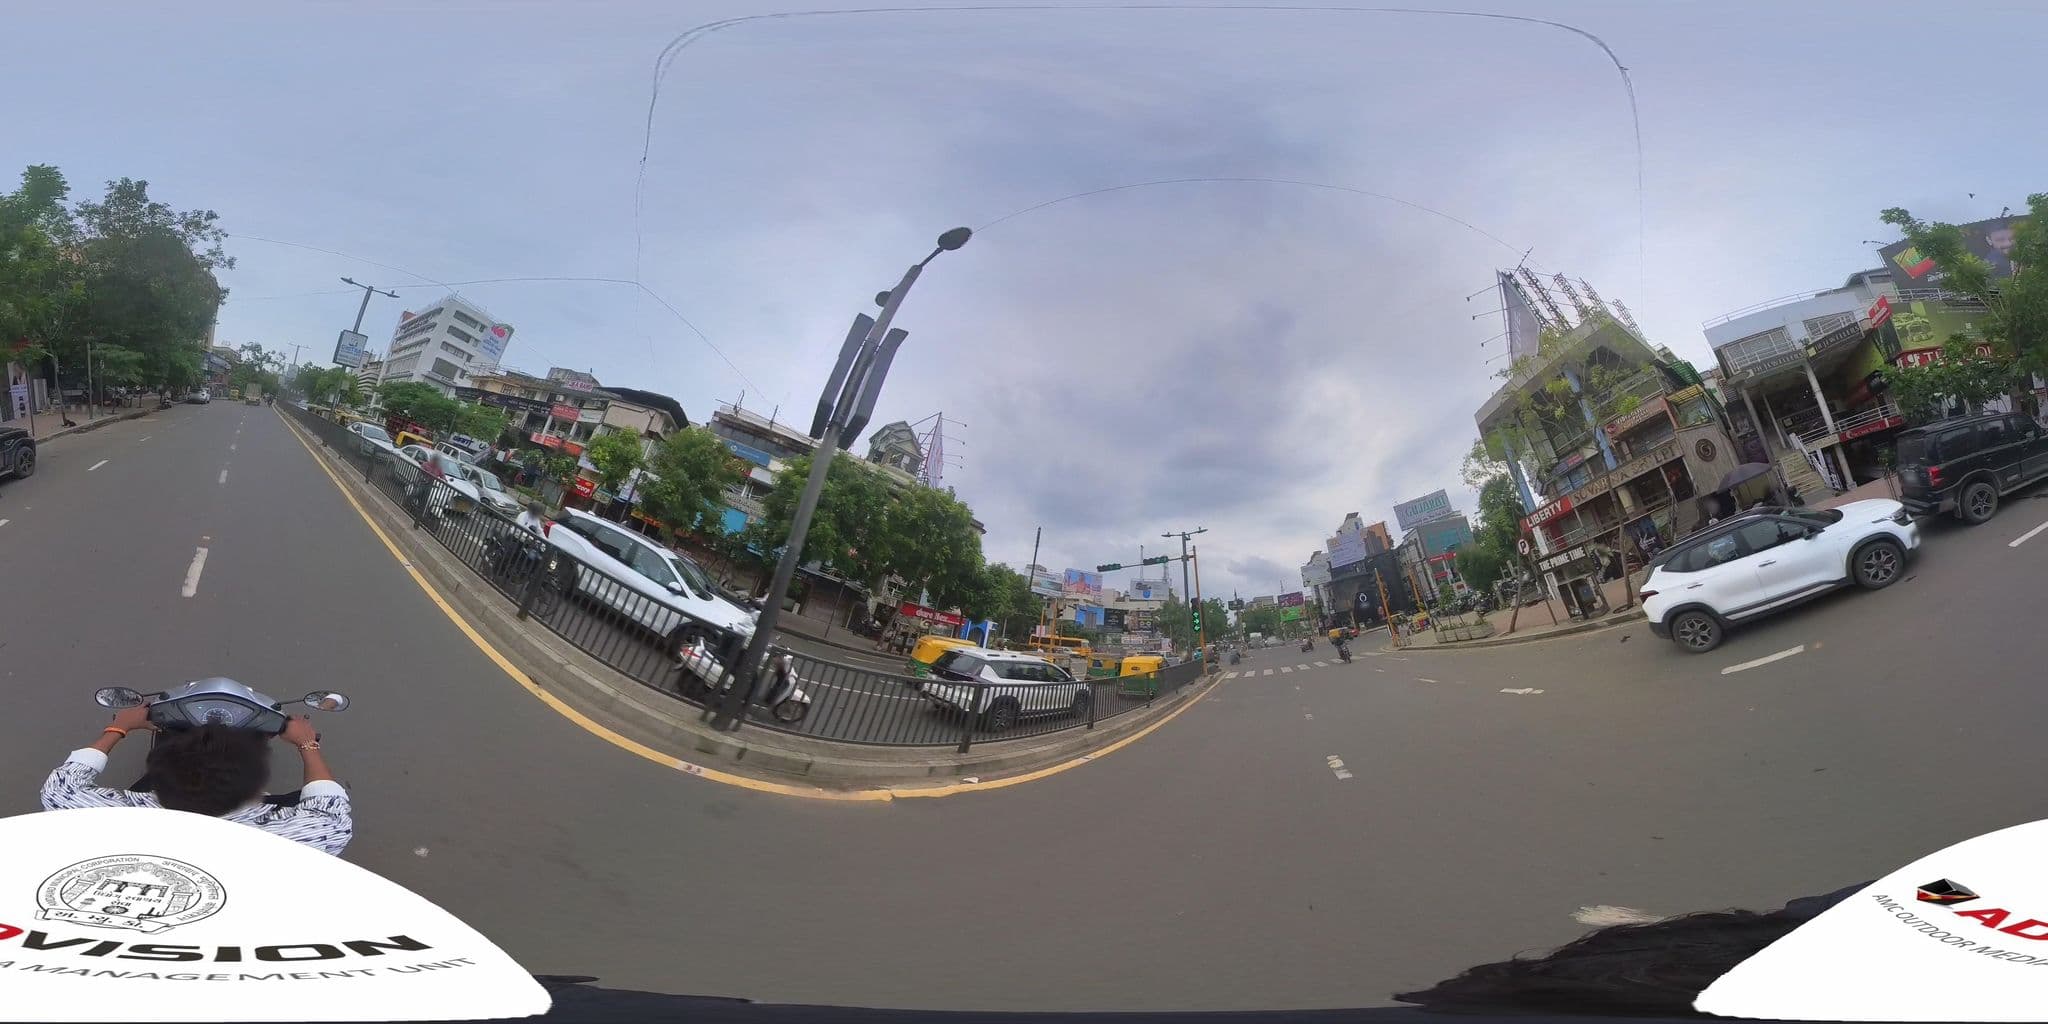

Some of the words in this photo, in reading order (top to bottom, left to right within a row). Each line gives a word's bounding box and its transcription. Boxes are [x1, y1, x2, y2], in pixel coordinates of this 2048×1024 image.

[1526, 501, 1562, 528] LIBERTY
[1538, 559, 1551, 571] THE
[1567, 546, 1585, 560] TIME
